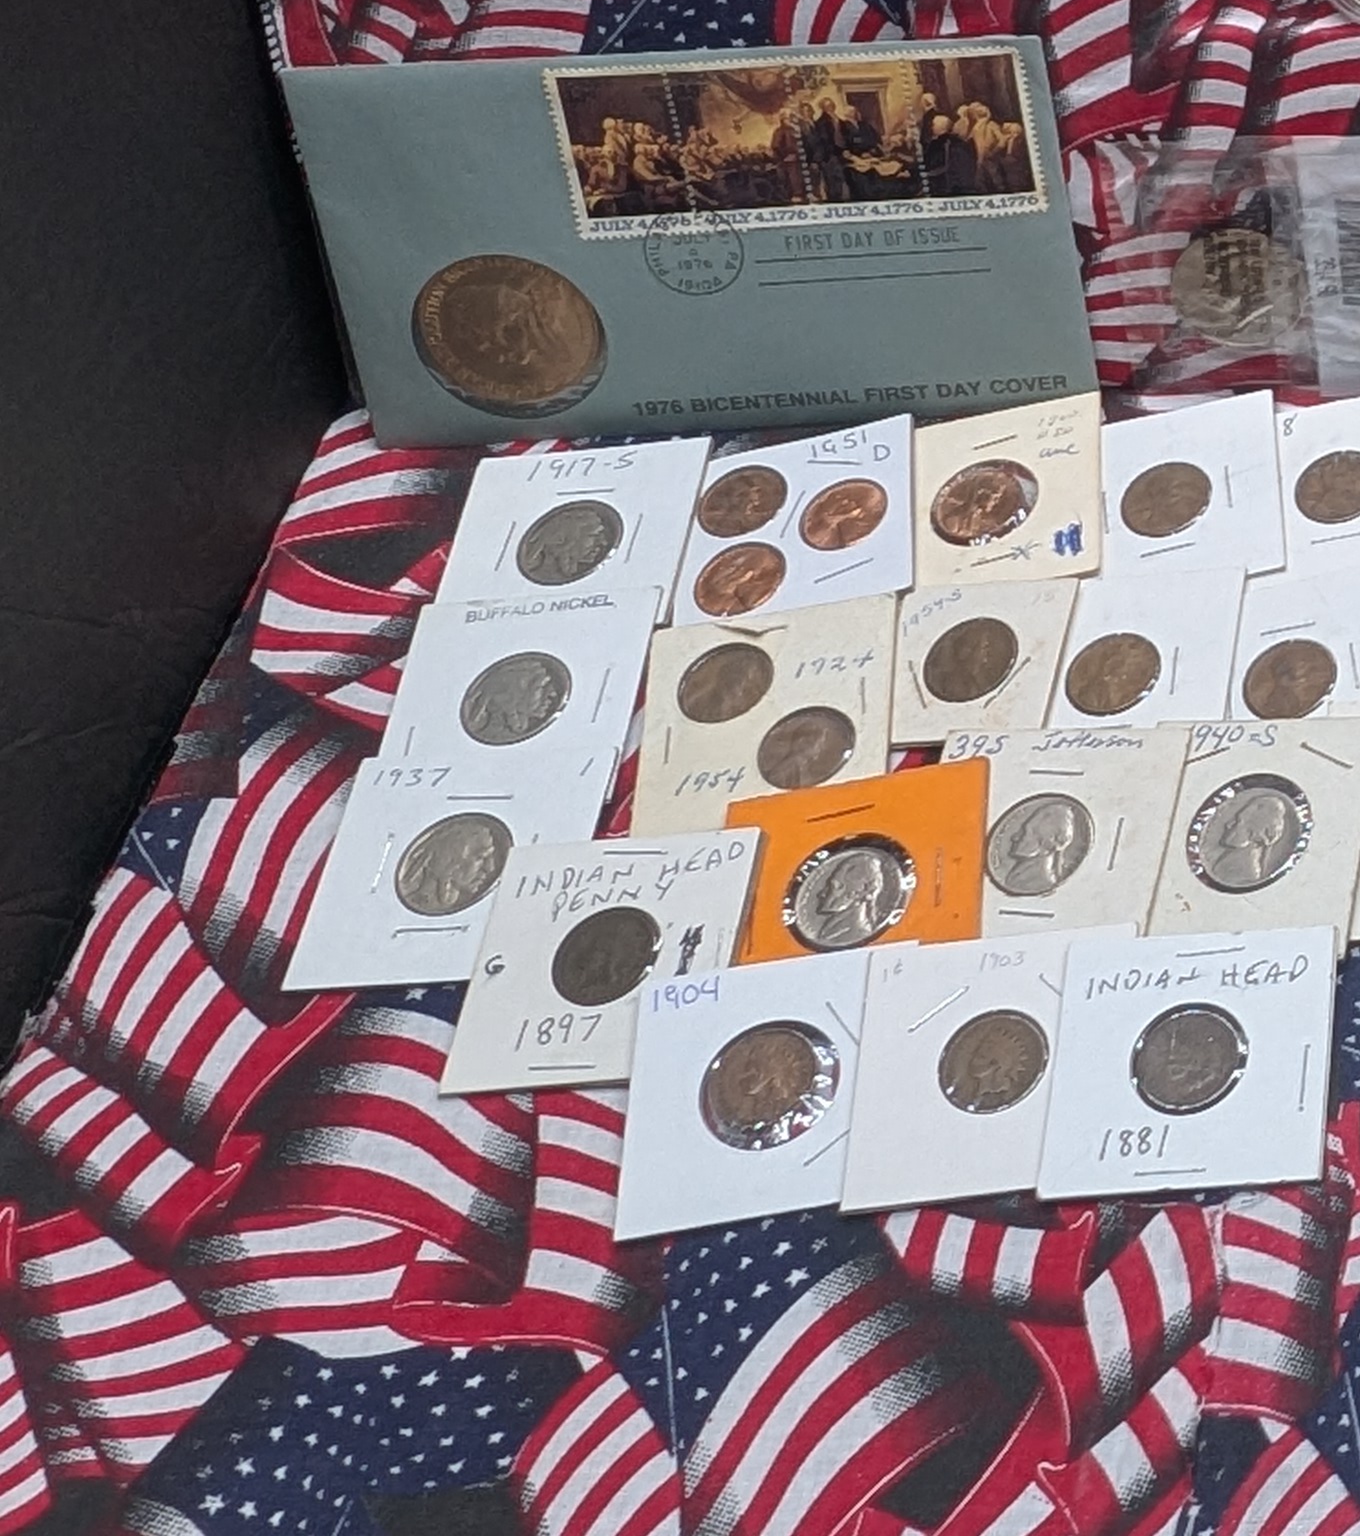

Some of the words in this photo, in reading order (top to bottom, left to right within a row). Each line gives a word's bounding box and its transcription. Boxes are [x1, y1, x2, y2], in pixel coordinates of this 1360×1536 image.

[824, 206, 867, 220] JULY
[937, 199, 984, 213] JULY
[589, 220, 636, 233] JULY
[784, 235, 834, 253] FIRST
[841, 233, 874, 250] DAY
[884, 231, 904, 247] OF
[912, 226, 962, 245] ISSUE
[632, 398, 684, 416] 1976
[689, 386, 859, 414] BICENTENNIAL
[864, 382, 928, 403] FIRST
[934, 379, 984, 400] DAY
[989, 373, 1068, 396] COVER
[873, 444, 892, 462] D
[464, 606, 547, 624] BUFFALO
[550, 593, 615, 617] NICKEL
[370, 766, 452, 788] 1937
[516, 863, 636, 899] INDIAN
[660, 840, 745, 881] HEAD
[552, 877, 679, 922] PENNY
[979, 951, 1026, 971] 1903
[652, 974, 721, 1012] 1904
[1086, 972, 1208, 1001] INDIAN
[1220, 955, 1311, 987] HEAD
[514, 1013, 602, 1053] 1897
[1099, 1124, 1172, 1162] 1881
